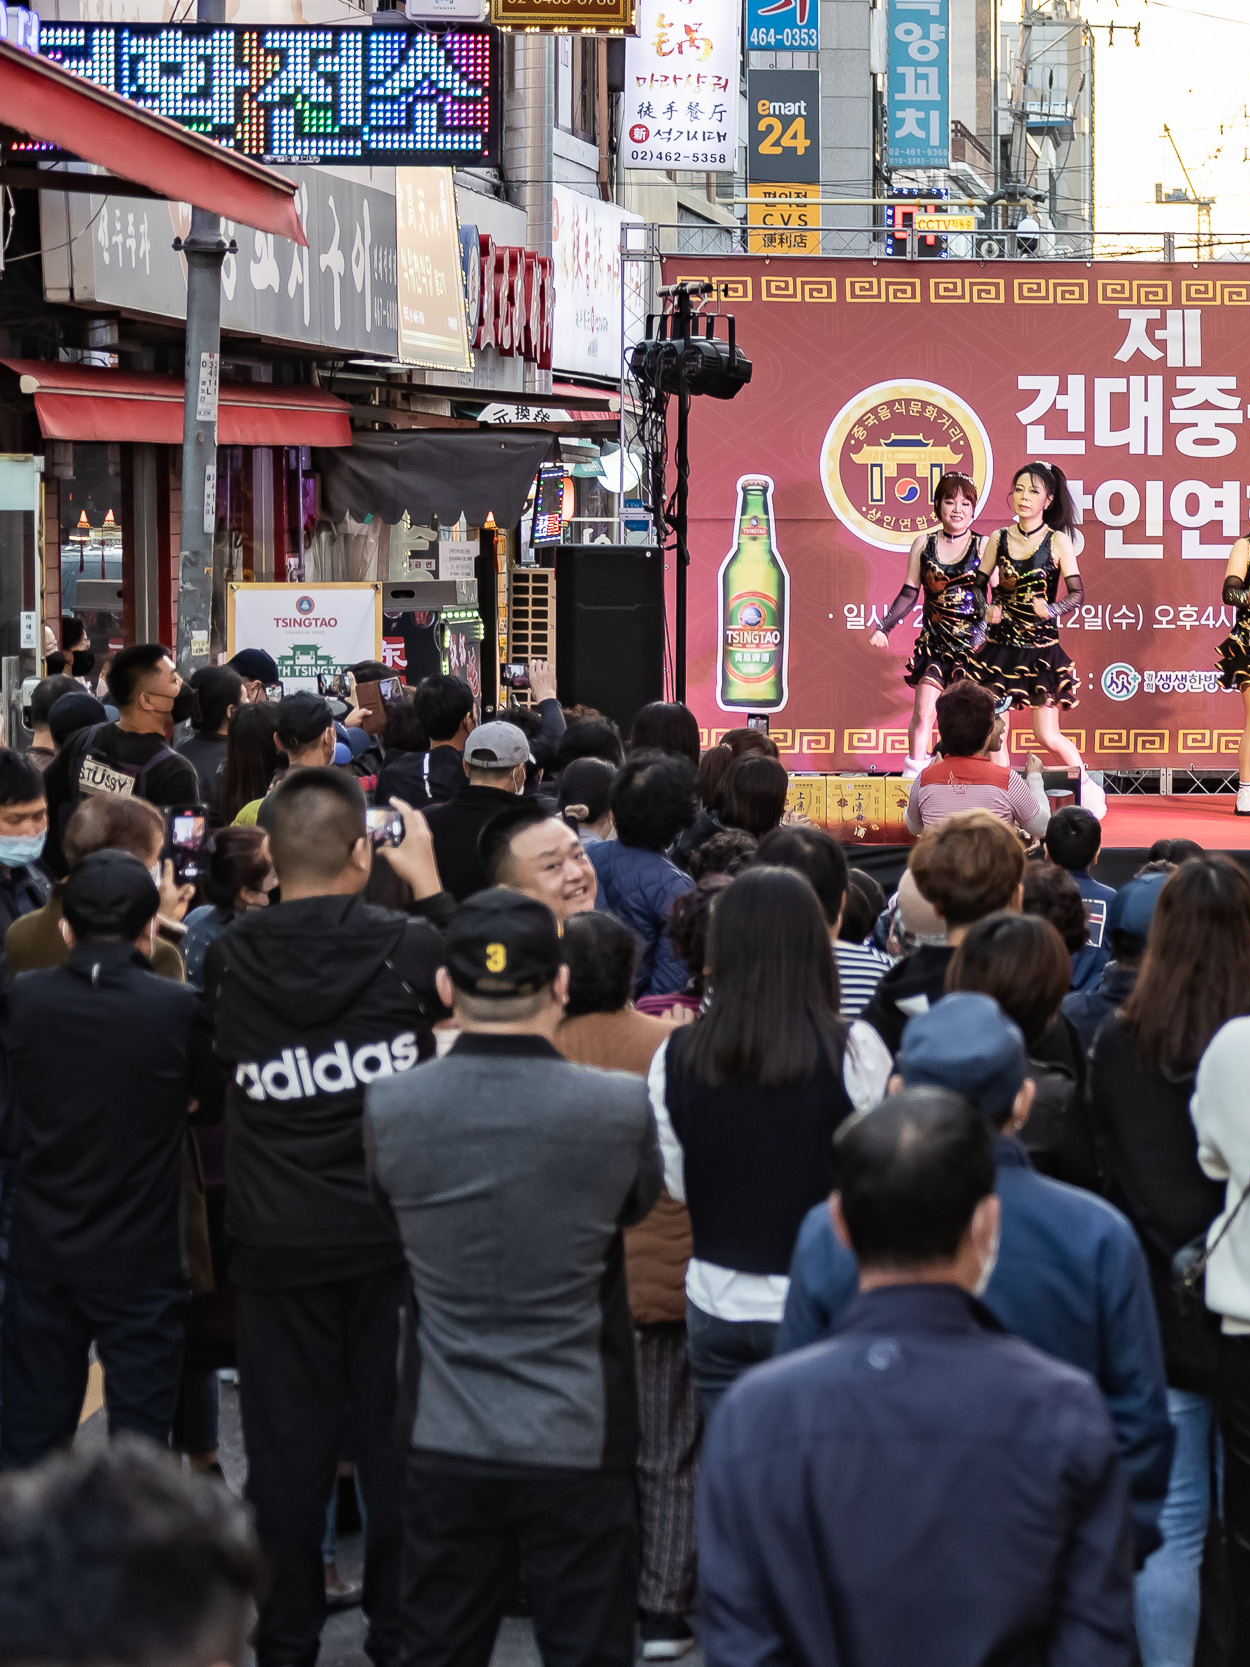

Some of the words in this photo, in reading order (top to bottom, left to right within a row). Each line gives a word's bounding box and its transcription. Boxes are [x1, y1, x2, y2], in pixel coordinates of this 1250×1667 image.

[750, 28, 818, 47] 464-0353
[757, 99, 807, 116] emart
[653, 128, 728, 143] 석기시대
[757, 116, 811, 155] 24
[631, 150, 727, 164] 02)462-5358
[762, 190, 808, 208] 편의점
[762, 232, 808, 249] 便利店
[1113, 309, 1202, 368] 제
[851, 400, 964, 443] 중국음식문화거리
[273, 617, 338, 628] TSINGTAO
[1153, 603, 1238, 631] 오후4시
[726, 630, 781, 645] TSINGTAO
[278, 665, 291, 676] TH
[1157, 671, 1227, 692] 생생한방
[485, 942, 507, 973] 3
[236, 1030, 419, 1101] adidas
